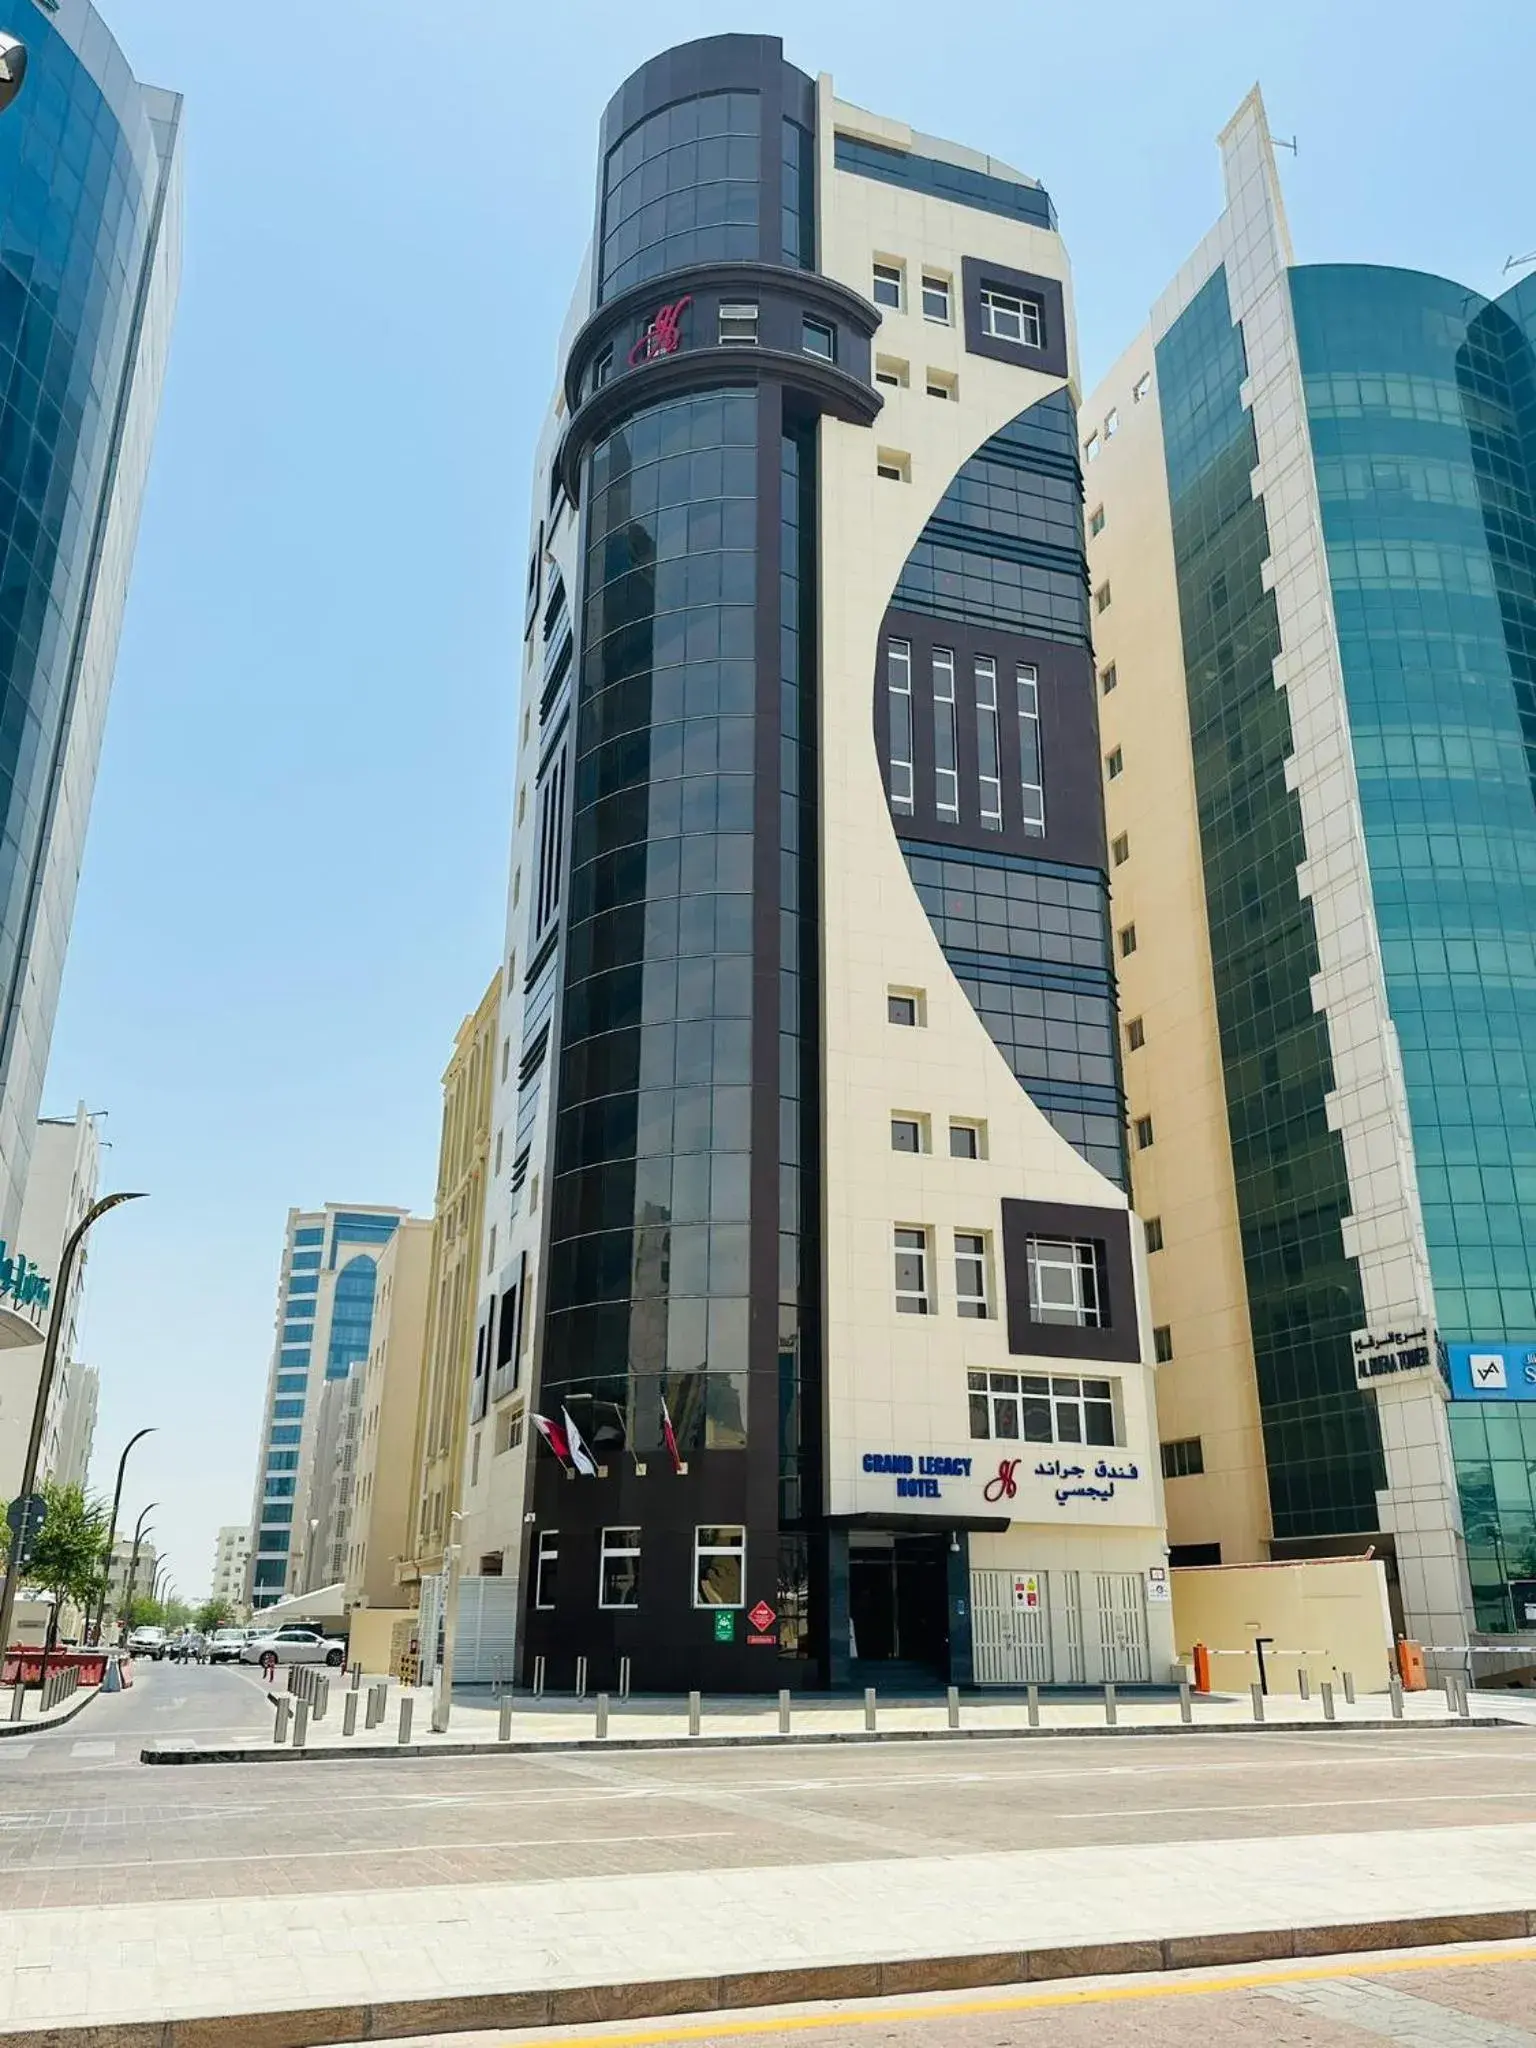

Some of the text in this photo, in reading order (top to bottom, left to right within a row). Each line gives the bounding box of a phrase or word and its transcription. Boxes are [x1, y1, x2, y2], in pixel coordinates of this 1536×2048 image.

[1396, 1346, 1430, 1371] TOWER
[862, 1453, 972, 1477] GRAND LEGACY
[1034, 1460, 1139, 1480] فندق جراند
[896, 1478, 942, 1498] HOTEL
[1055, 1481, 1115, 1506] ليجسي
